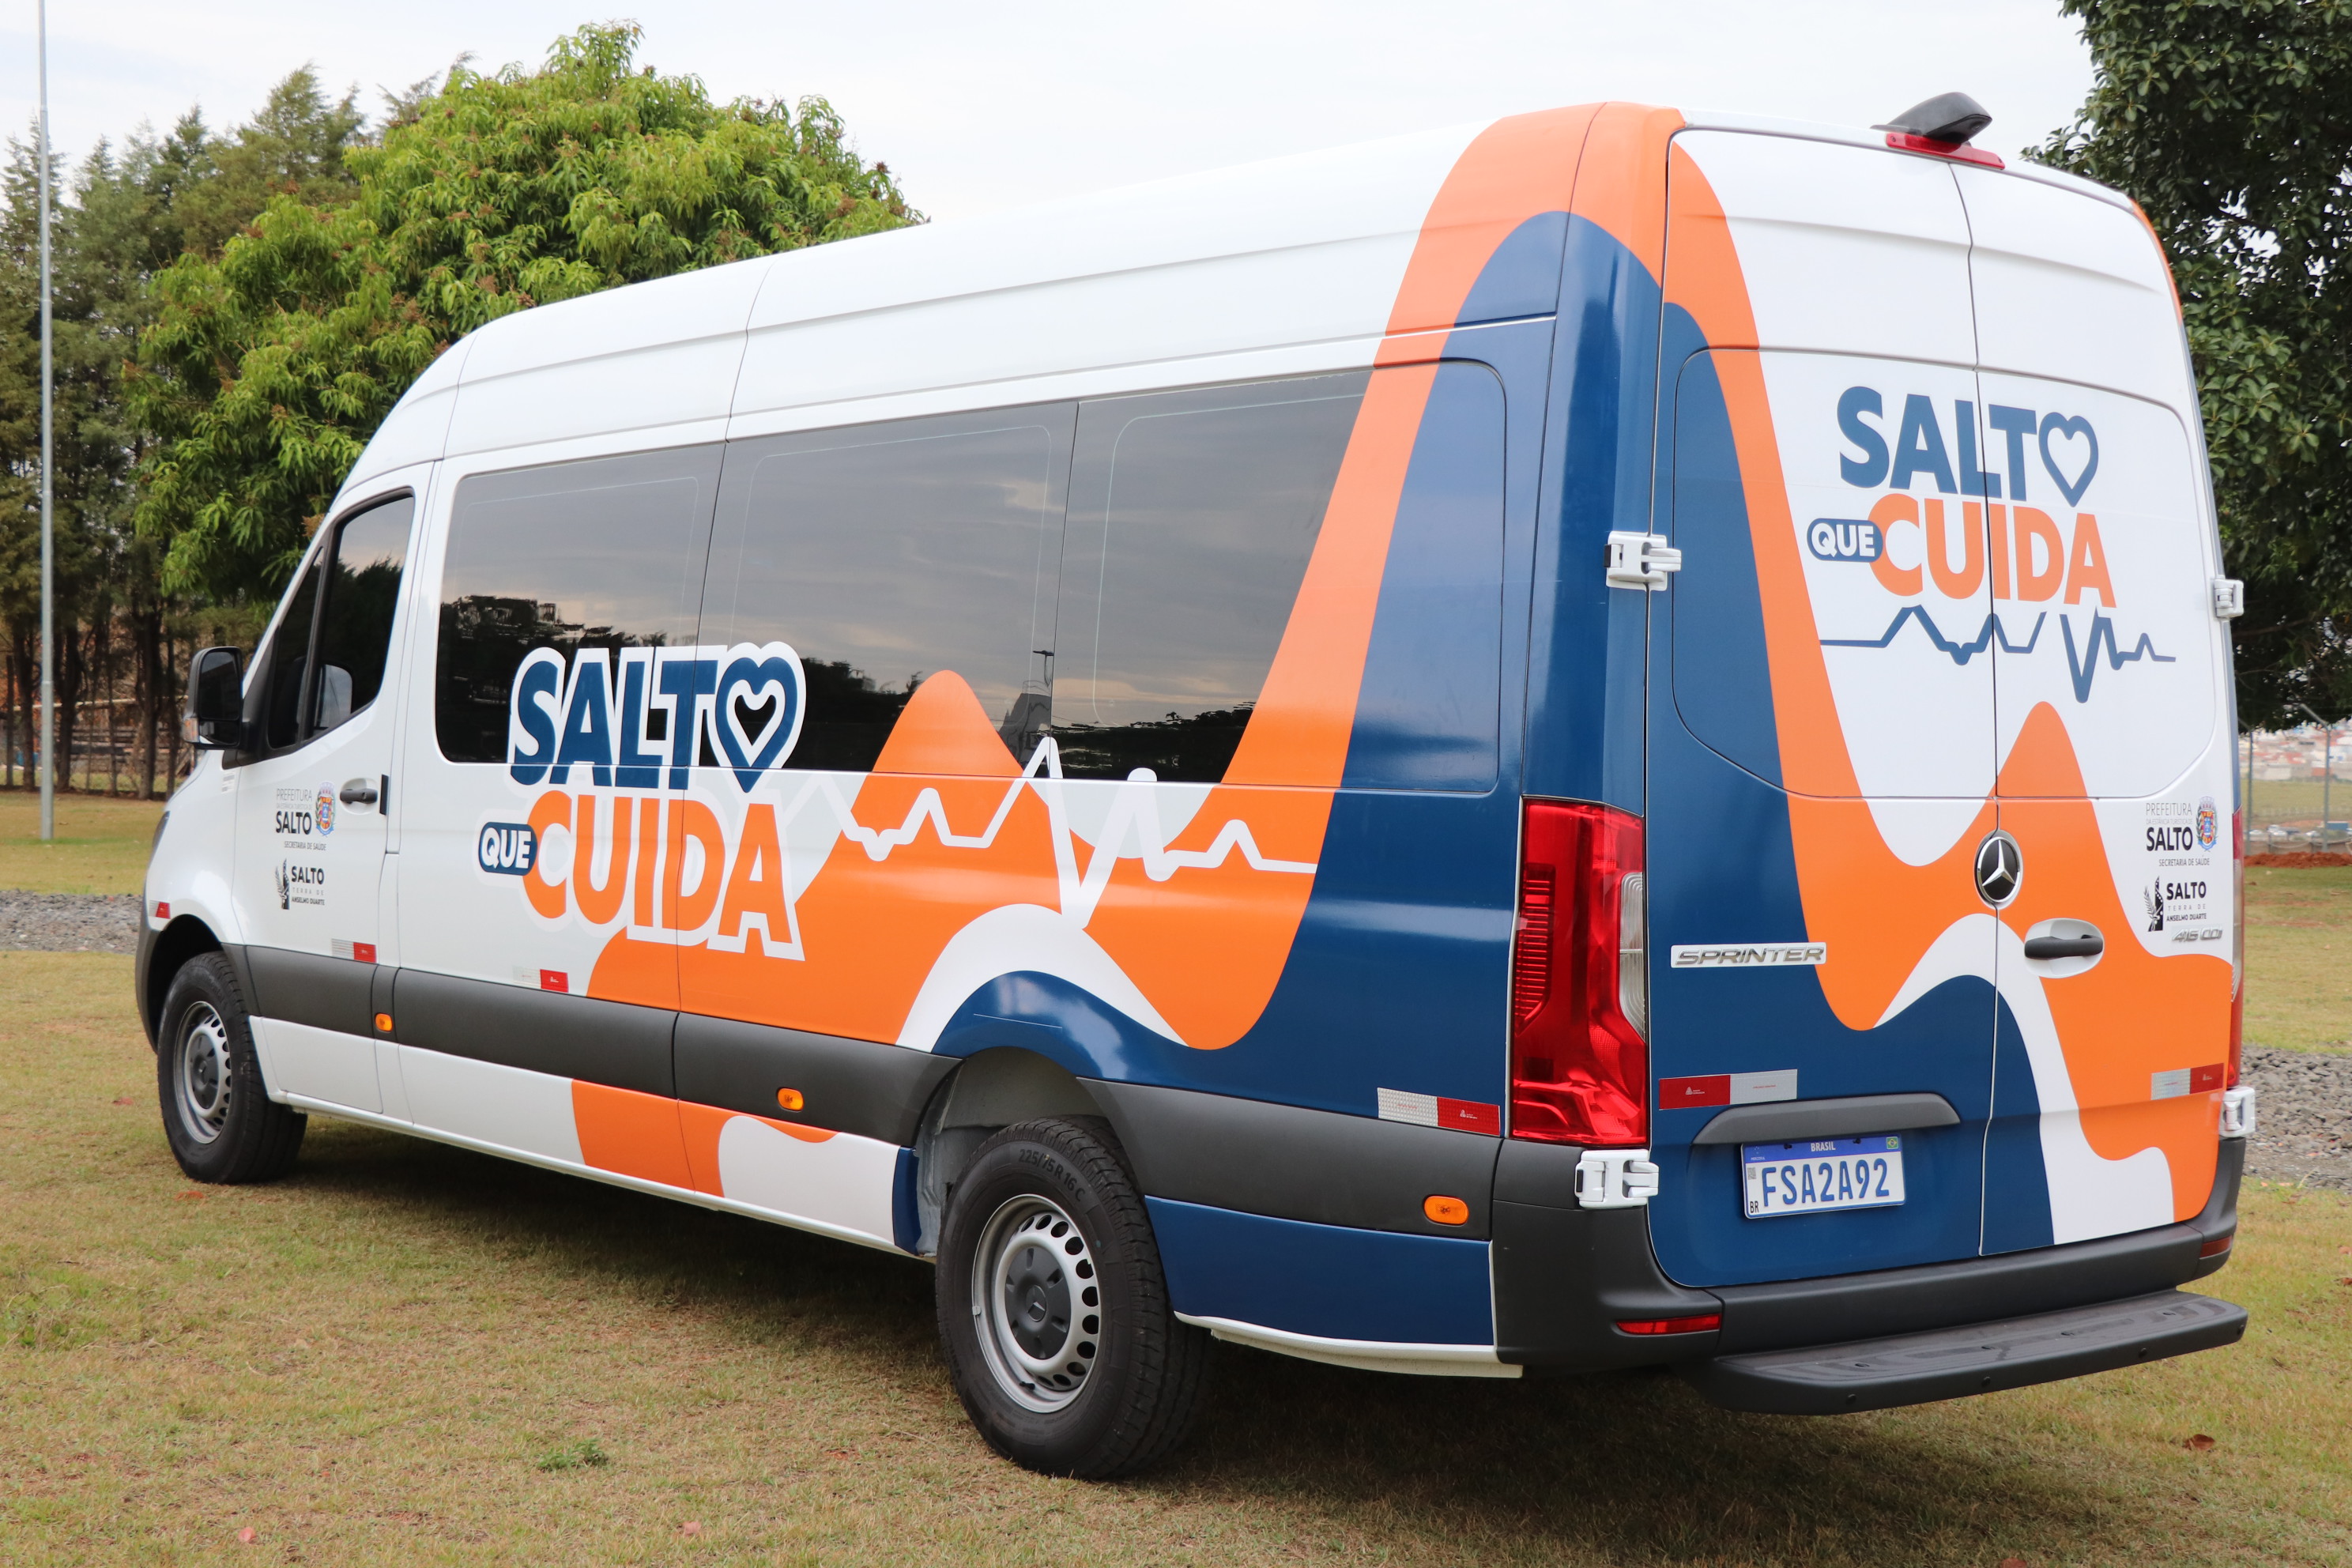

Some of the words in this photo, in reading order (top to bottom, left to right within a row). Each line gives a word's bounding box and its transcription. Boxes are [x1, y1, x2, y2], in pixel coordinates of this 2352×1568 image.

[1811, 522, 1875, 558] QUE
[1867, 493, 2116, 608] CUIDA
[277, 788, 313, 801] PREFEITURA
[2146, 802, 2192, 816] PREFEITURA
[276, 810, 312, 835] SALTO
[285, 841, 306, 850] SECRETARIA
[2147, 827, 2193, 851] SALTO
[481, 826, 533, 869] QUE
[522, 790, 793, 944] CUIDA
[2196, 854, 2210, 865] SAÚDE
[292, 865, 325, 884] SALTO
[2166, 881, 2207, 900] SALTO
[1675, 946, 1824, 965] SPRINTER
[1811, 1141, 1836, 1152] BRASIL
[1761, 1158, 1890, 1207] FSA2A92
[1750, 1200, 1759, 1213] BR
